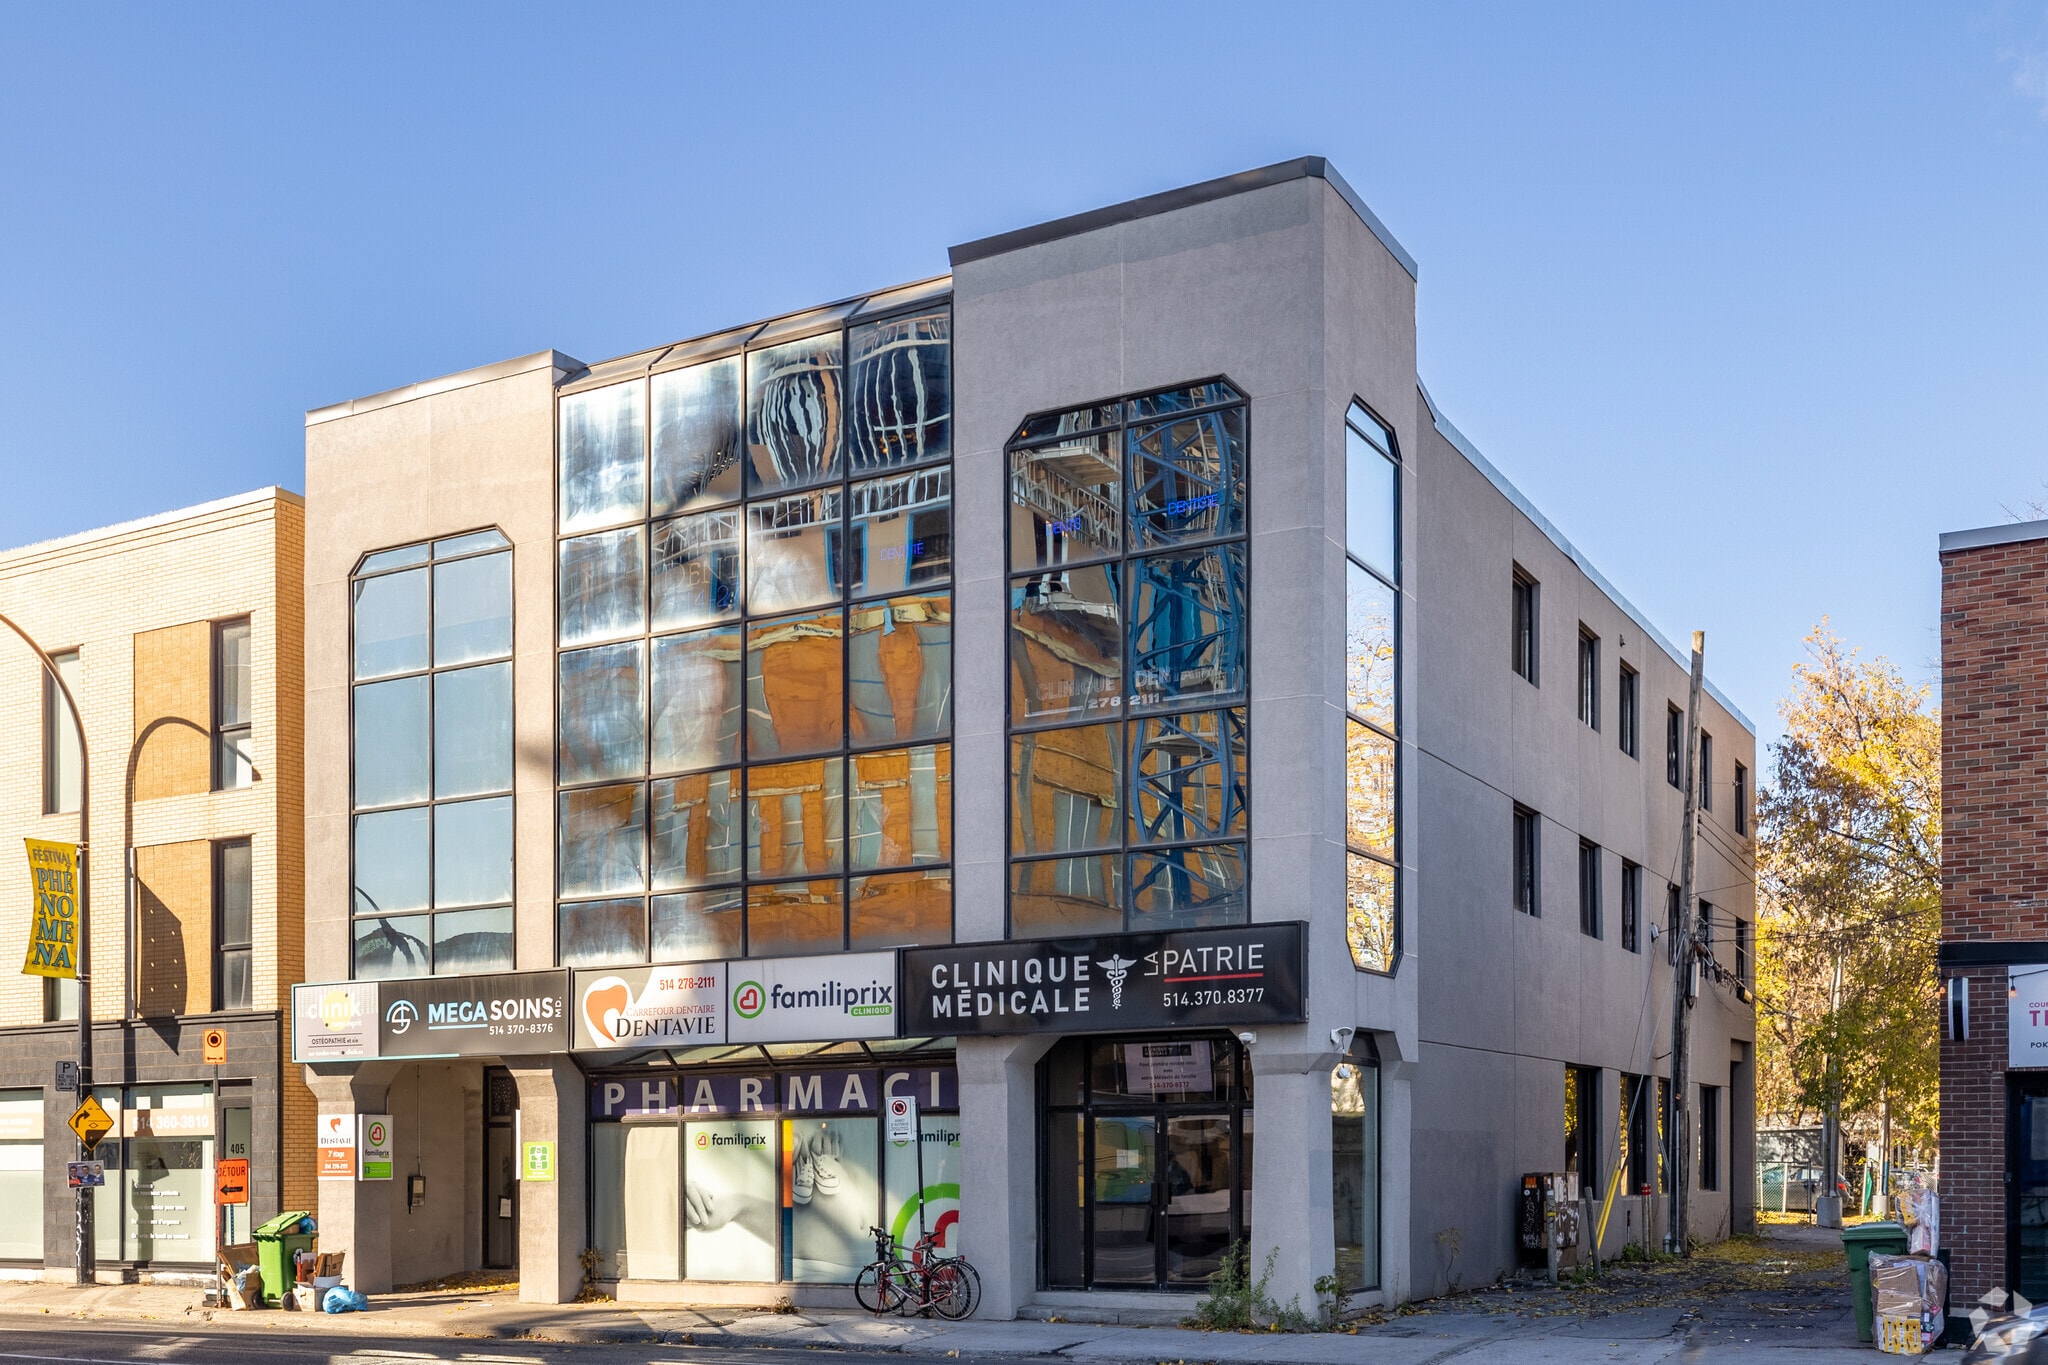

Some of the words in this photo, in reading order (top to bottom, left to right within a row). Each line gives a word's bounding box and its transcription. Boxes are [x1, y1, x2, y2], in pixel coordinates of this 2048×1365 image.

[1087, 695, 1122, 709] 278
[1129, 692, 1161, 706] 2111
[32, 848, 71, 864] FESTIVAL
[39, 892, 75, 918] NO
[36, 917, 74, 944] ME
[32, 942, 72, 969] NA
[1143, 950, 1160, 976] LA
[1163, 943, 1265, 975] PATRIE
[931, 955, 1091, 989] CLINIQUE
[659, 978, 674, 991] 514
[678, 975, 715, 989] 278-2111
[771, 980, 893, 1014] familiprix
[1162, 988, 1265, 1008] 514.370.8377
[626, 1006, 675, 1017] CARREFOUR
[676, 1004, 715, 1015] DENTAIRE
[853, 1006, 890, 1016] CLINIQUE
[489, 1025, 504, 1036] 514
[506, 1023, 554, 1035] 370-8376
[615, 1016, 716, 1038] DENTAVIE
[62, 1063, 71, 1074] P
[604, 1071, 960, 1116] PHARMACI
[231, 1143, 245, 1154] 405
[712, 1133, 766, 1149] familiprix
